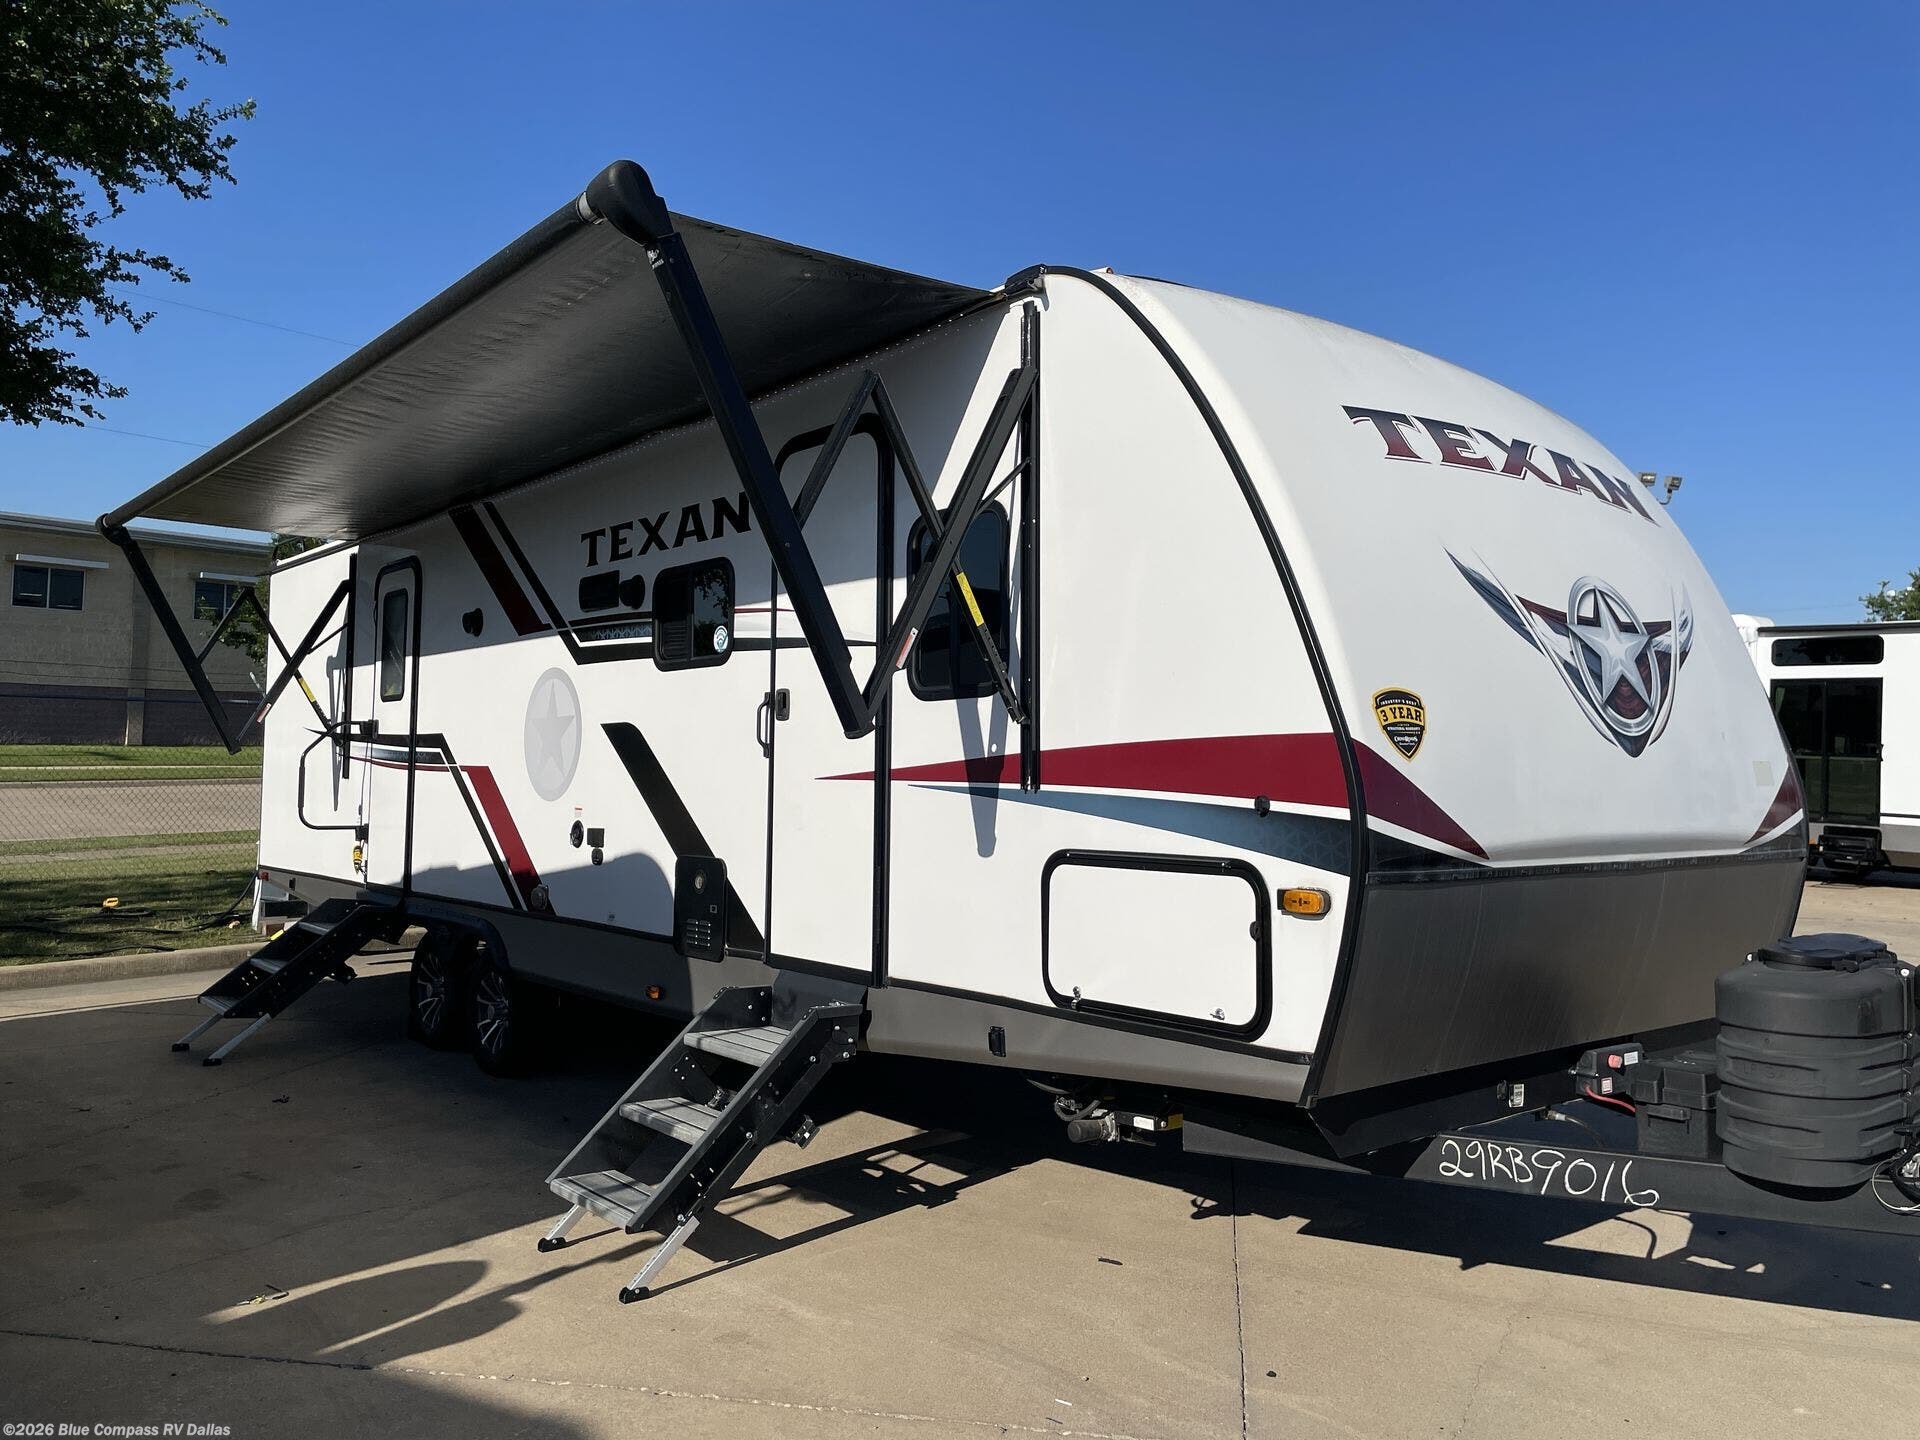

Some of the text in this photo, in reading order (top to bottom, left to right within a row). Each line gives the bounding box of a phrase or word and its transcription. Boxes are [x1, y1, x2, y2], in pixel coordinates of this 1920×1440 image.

[1341, 405, 1659, 525] TEXAN
[580, 492, 752, 567] TEXAN
[1380, 707, 1422, 722] 3 YEAR
[1438, 1138, 1660, 1207] 29RB9016
